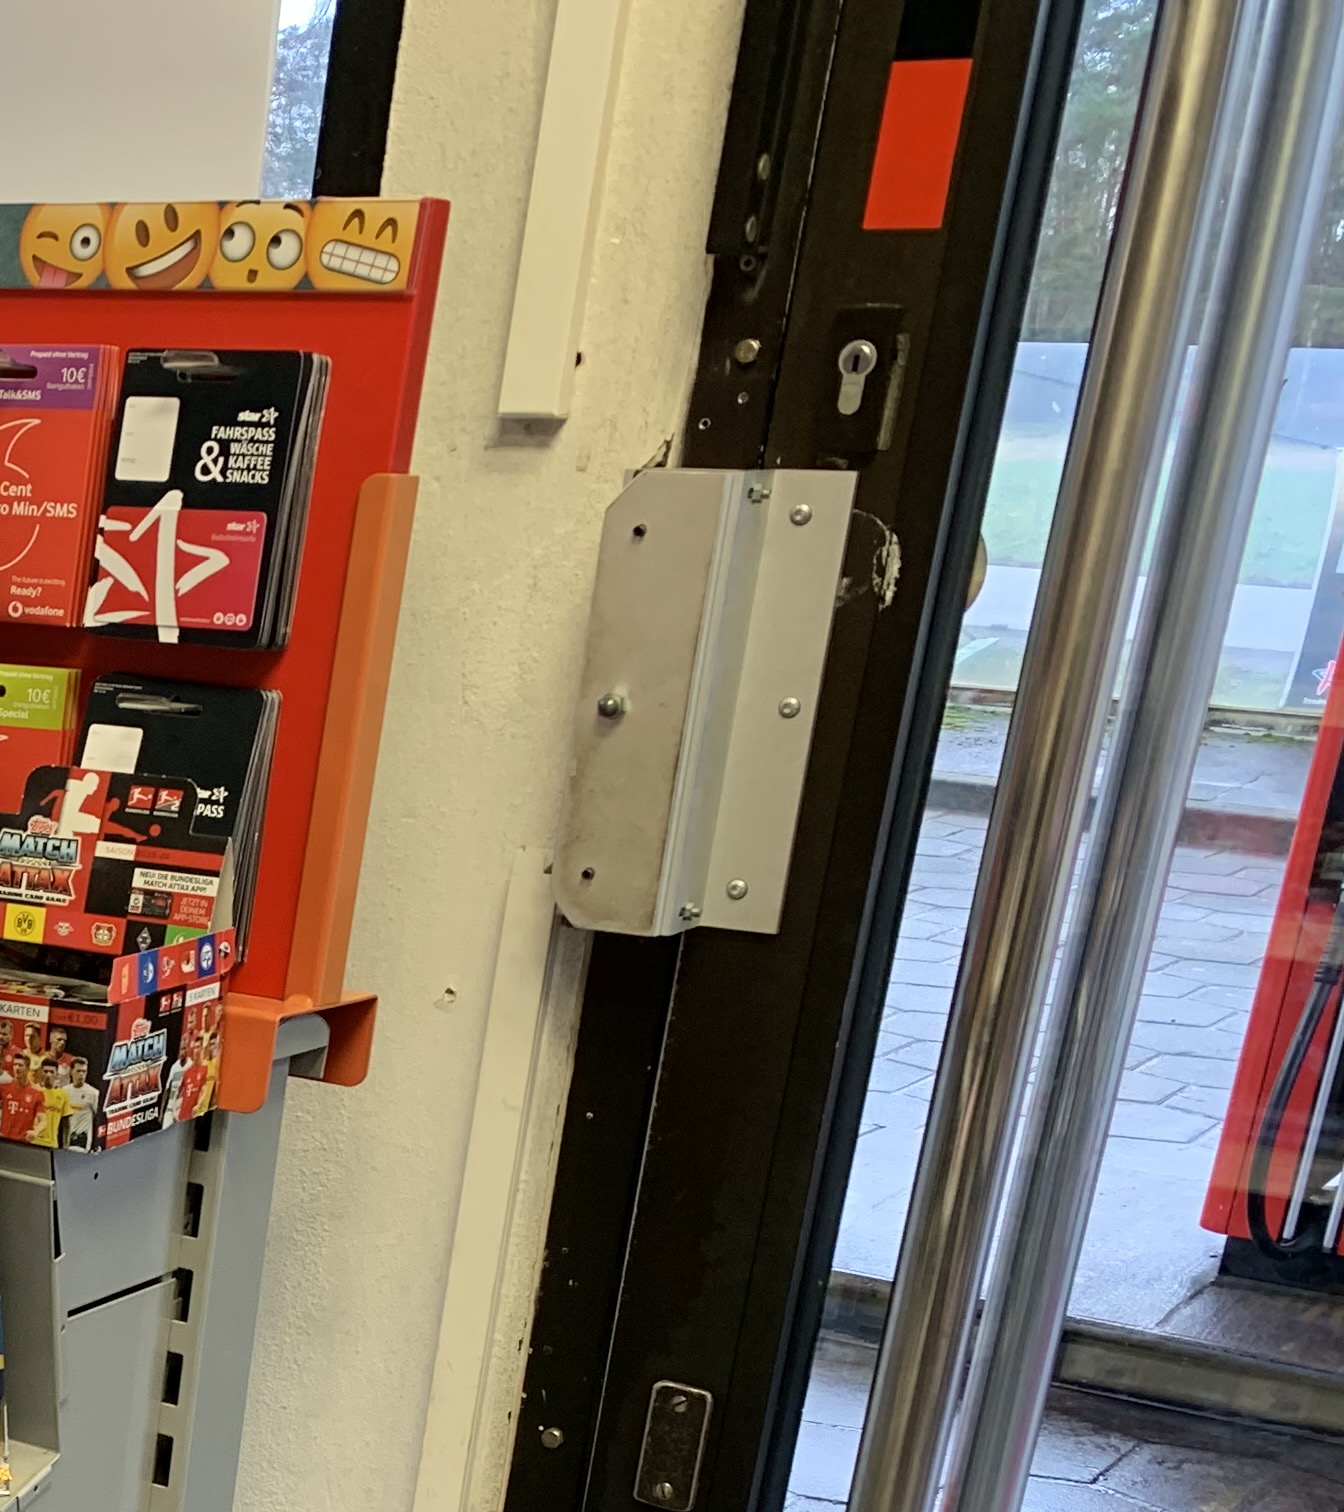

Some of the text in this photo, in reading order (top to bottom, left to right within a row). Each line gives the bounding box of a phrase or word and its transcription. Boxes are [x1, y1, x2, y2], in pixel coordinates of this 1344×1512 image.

[212, 426, 275, 440] FAHRSPASS
[230, 439, 273, 455] WÄSCHE
[228, 455, 271, 470] KAFFEE
[226, 469, 269, 485] SNACKS
[5, 481, 32, 498] Cent
[12, 501, 77, 520] Min/SMS
[24, 605, 64, 616] vodafone
[106, 1107, 159, 1135] BUNDESLIGA
